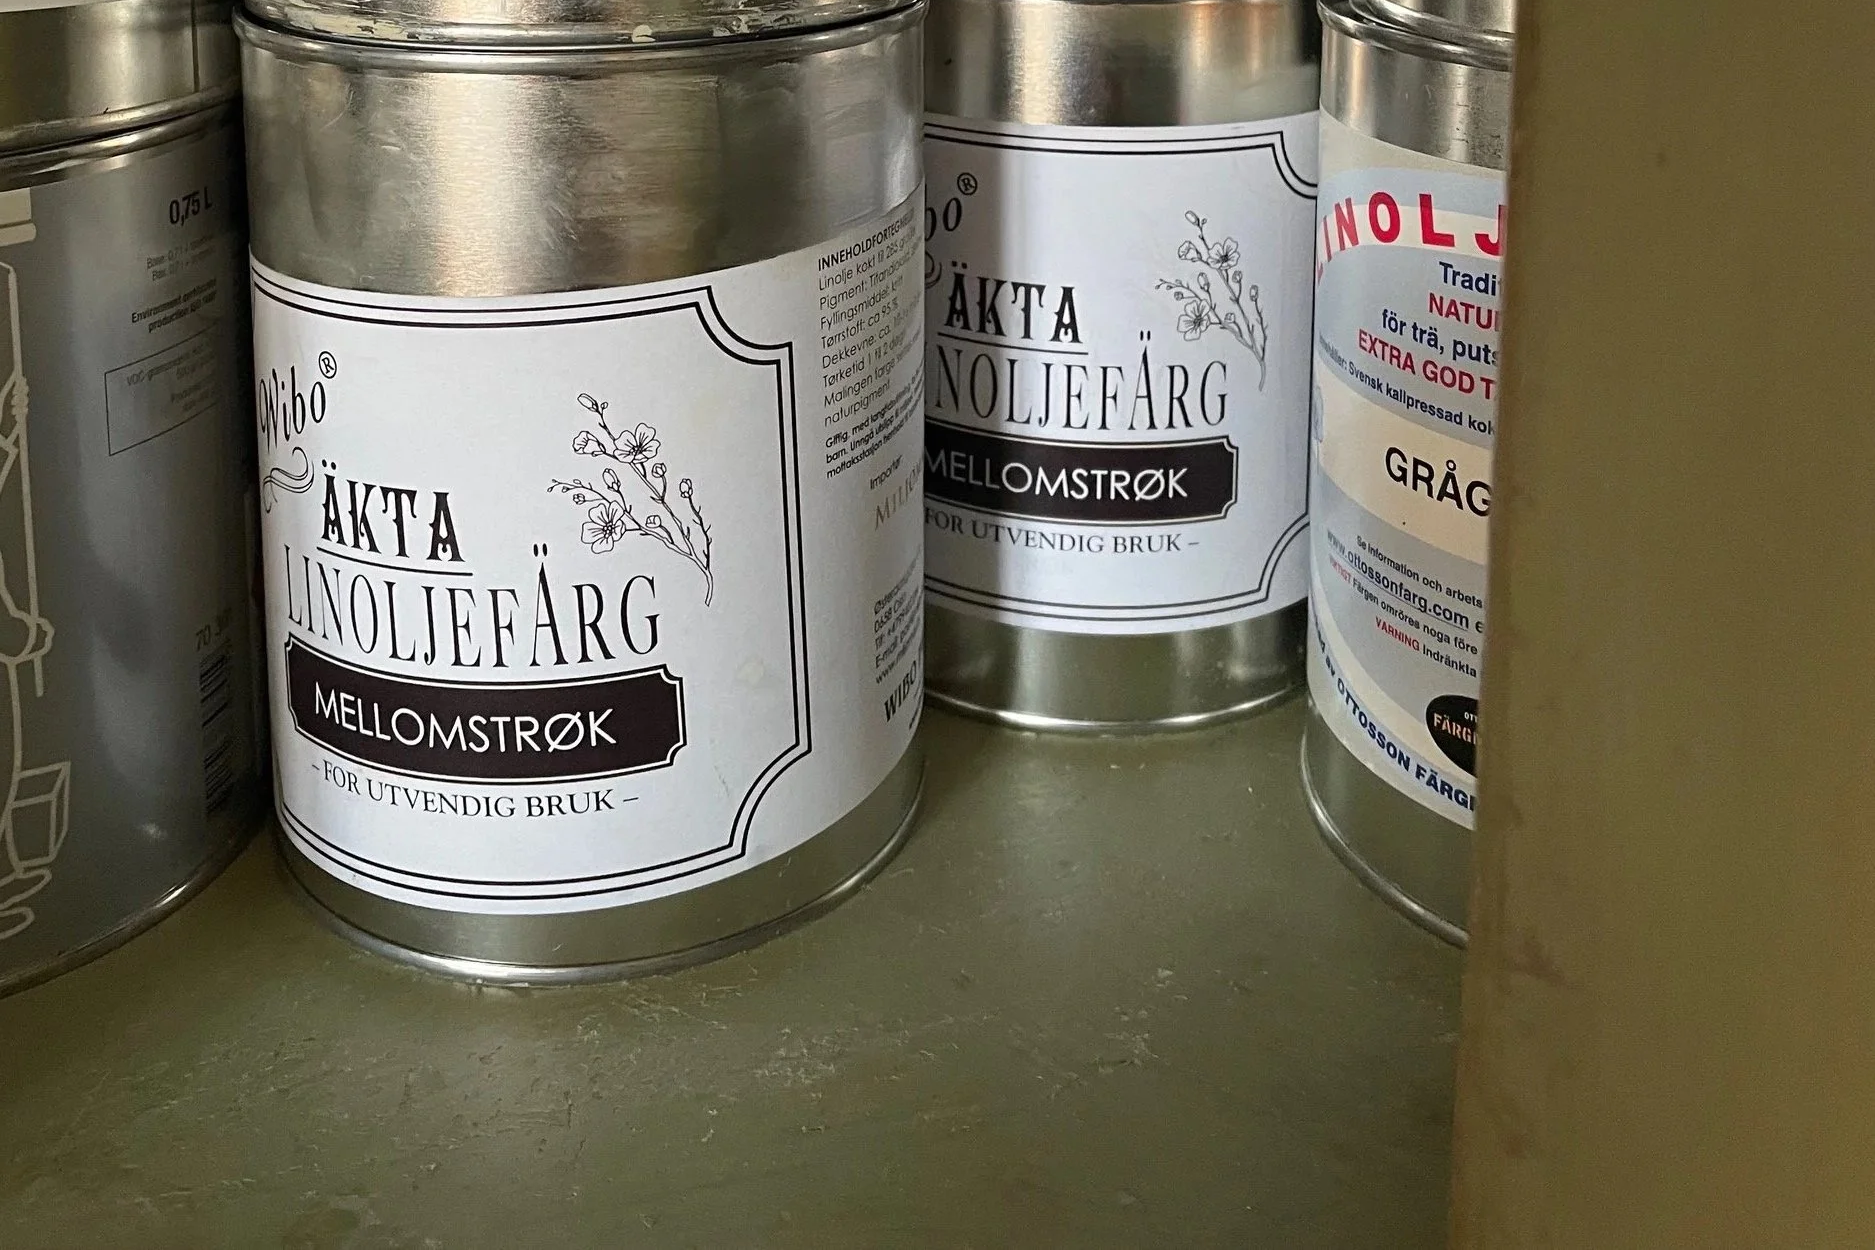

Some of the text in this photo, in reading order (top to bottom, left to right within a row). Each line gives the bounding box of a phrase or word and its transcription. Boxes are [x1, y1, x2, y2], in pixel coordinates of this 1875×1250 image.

[944, 260, 1083, 345] ÄKTA
[1382, 309, 1444, 357] för trä,
[1348, 361, 1463, 427] Svensk kallpressad
[1358, 329, 1416, 376] EXTRA
[1422, 360, 1474, 394] GOD
[321, 458, 465, 563] ÄKTA
[971, 514, 1105, 553] UTVENDIG
[1113, 533, 1182, 553] BRUK
[284, 543, 660, 668] LINOLJEFÄRG
[1422, 574, 1442, 593] och
[1375, 617, 1420, 652] VARNING
[1423, 624, 1450, 645] noga
[1453, 633, 1479, 656] före
[314, 682, 617, 753] MELLOMSTRØK
[1337, 677, 1411, 773] OTTOSSON
[323, 760, 614, 818] FOR UTVENDIG BRUK
